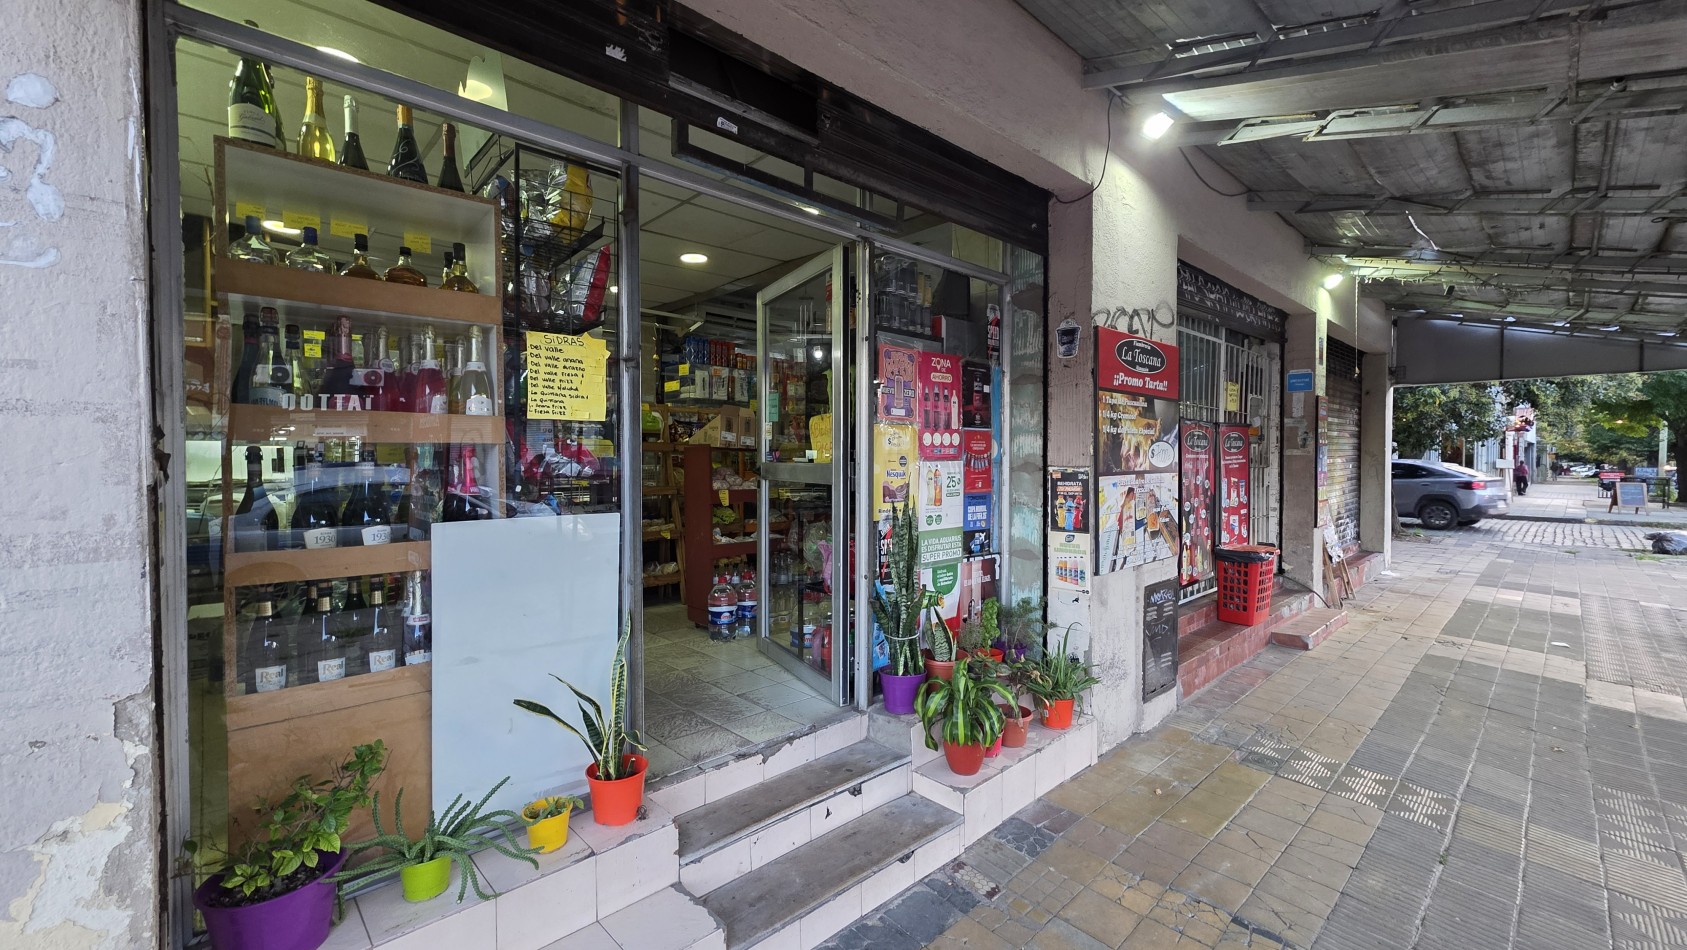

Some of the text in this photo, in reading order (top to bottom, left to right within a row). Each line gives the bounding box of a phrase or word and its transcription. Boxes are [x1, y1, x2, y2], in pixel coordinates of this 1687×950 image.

[1122, 346, 1161, 366] La Toscana
[932, 358, 952, 370] ZONA
[1114, 372, 1168, 391] ¡¡Promo Tarta!!
[1110, 410, 1117, 420] kg
[1110, 426, 1117, 435] kg
[886, 470, 906, 479] Nesquik
[314, 535, 336, 544] 1930
[928, 543, 951, 551] DISFRUTAR
[942, 550, 960, 559] PROMO
[374, 652, 394, 665] Real
[322, 661, 343, 675] Real
[260, 668, 284, 683] Real
